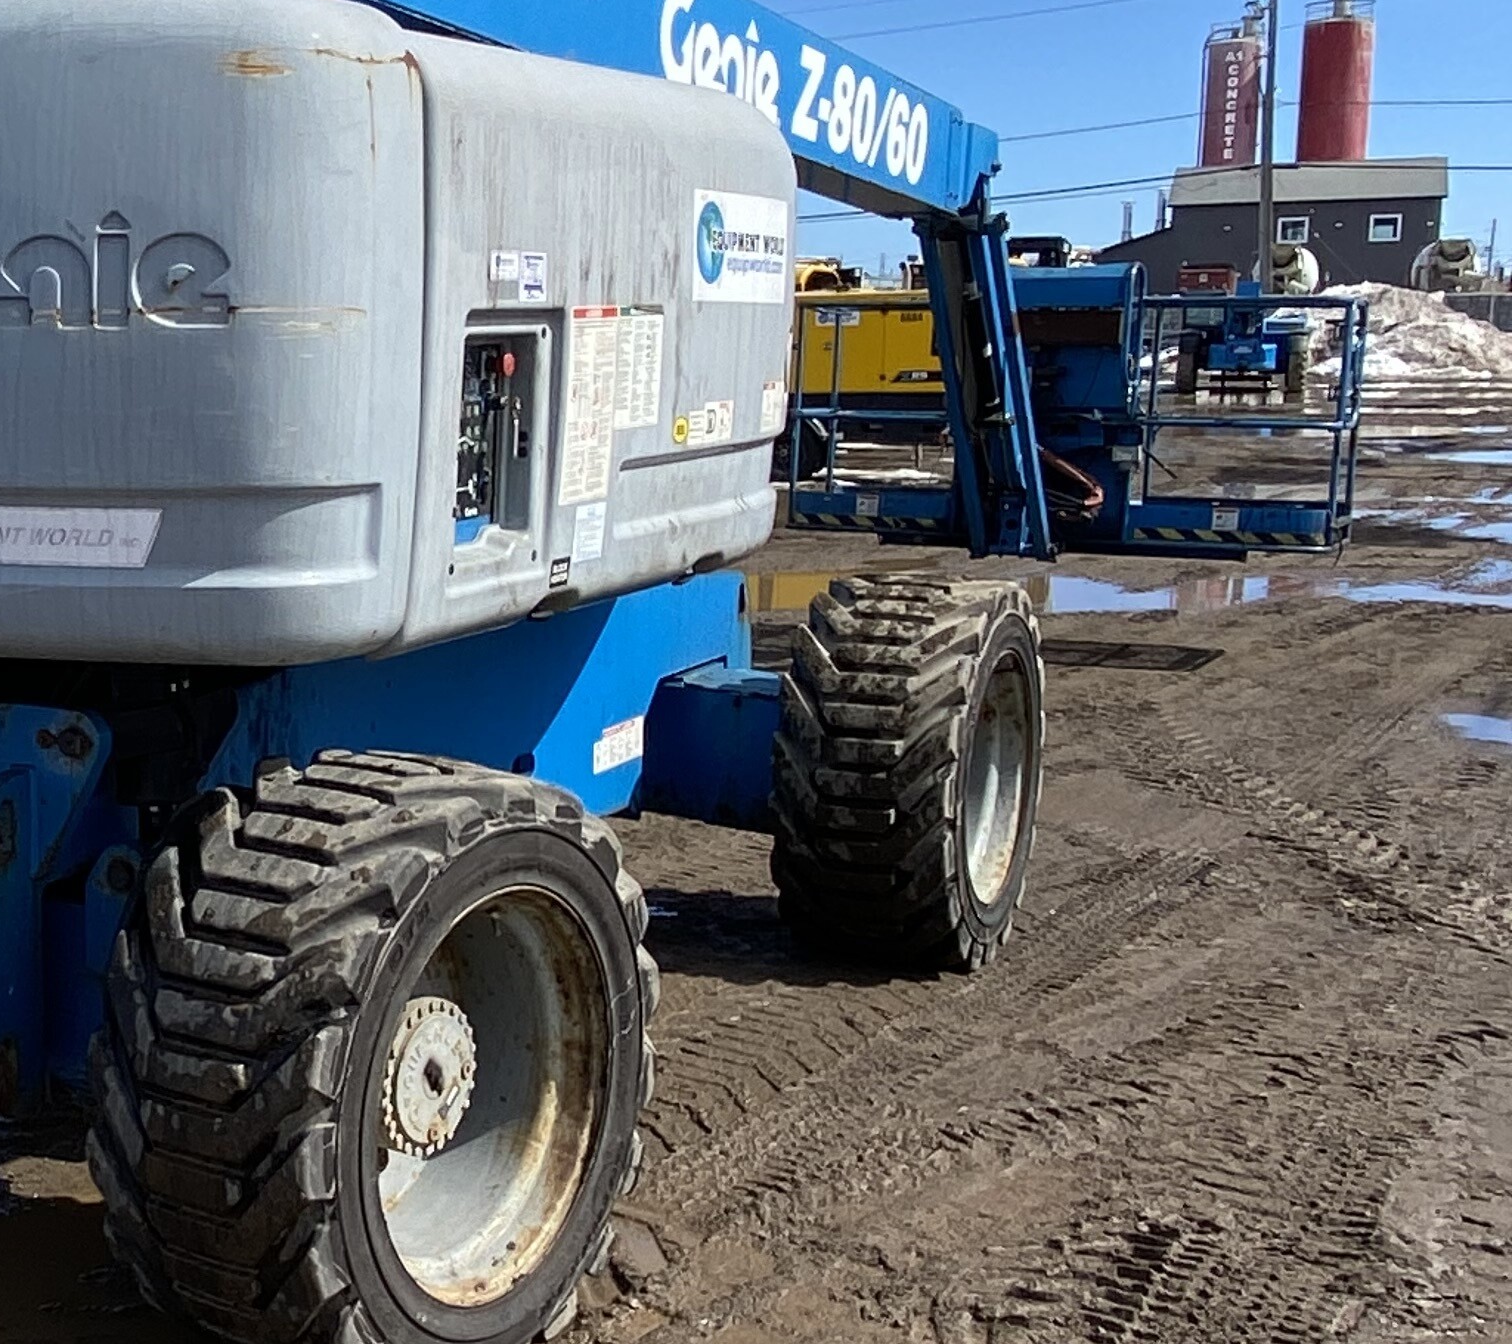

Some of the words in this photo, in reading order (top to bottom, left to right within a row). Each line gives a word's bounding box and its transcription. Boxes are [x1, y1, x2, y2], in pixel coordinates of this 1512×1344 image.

[1225, 50, 1244, 62] A1
[791, 44, 928, 185] Z-80/60
[1223, 64, 1240, 160] CONCRETE
[29, 527, 115, 547] WORLD
